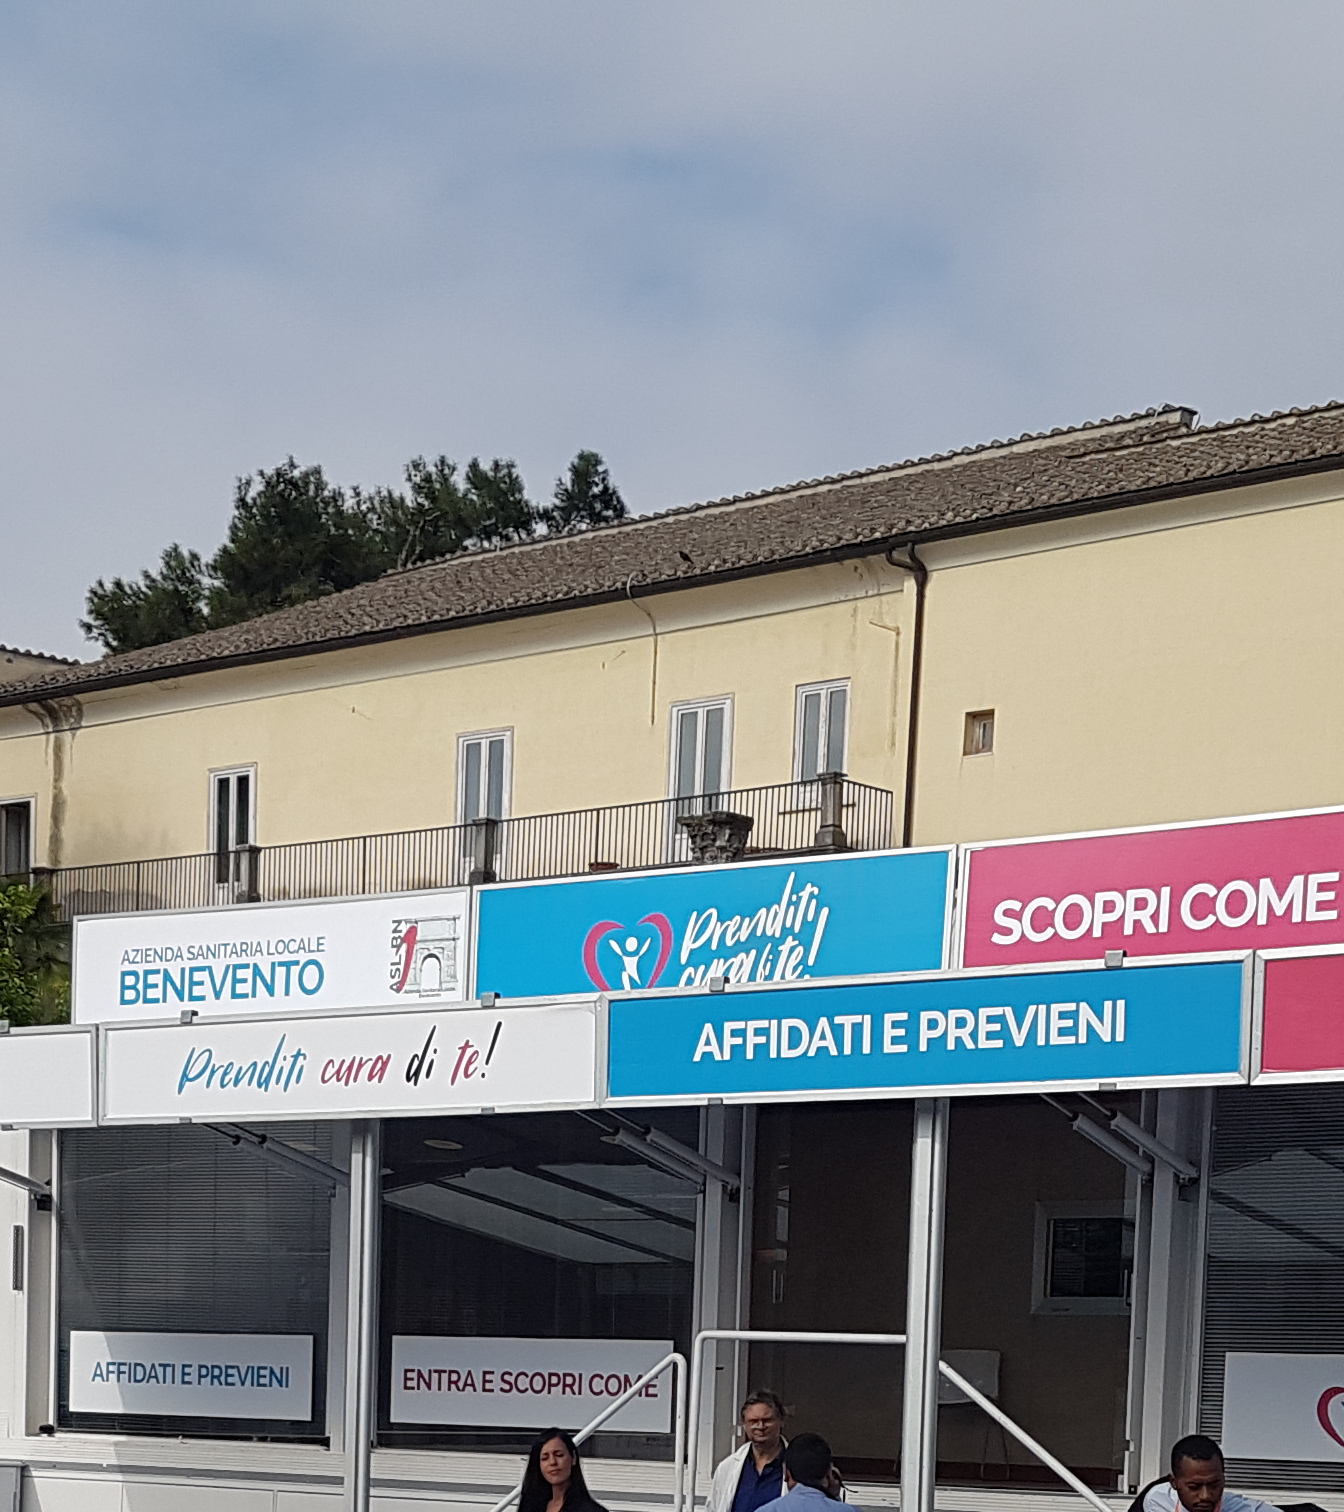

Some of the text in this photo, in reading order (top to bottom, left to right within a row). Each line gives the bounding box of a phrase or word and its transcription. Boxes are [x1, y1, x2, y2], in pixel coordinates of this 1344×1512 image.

[680, 872, 818, 965] Prenditi
[990, 872, 1340, 945] SCOPRI COME
[121, 936, 325, 965] AZIENDA SANITARIA LOCALE
[120, 958, 325, 1005] BENEVENTO
[178, 1021, 502, 1095] Prenditi cura di te!
[693, 999, 1126, 1062] AFFIDATI E PREVIENI
[92, 1362, 290, 1388] AFFIDATI E PREVIENI
[403, 1369, 477, 1392] ENTRA
[482, 1371, 494, 1392] E
[499, 1371, 583, 1396] SCOPRI
